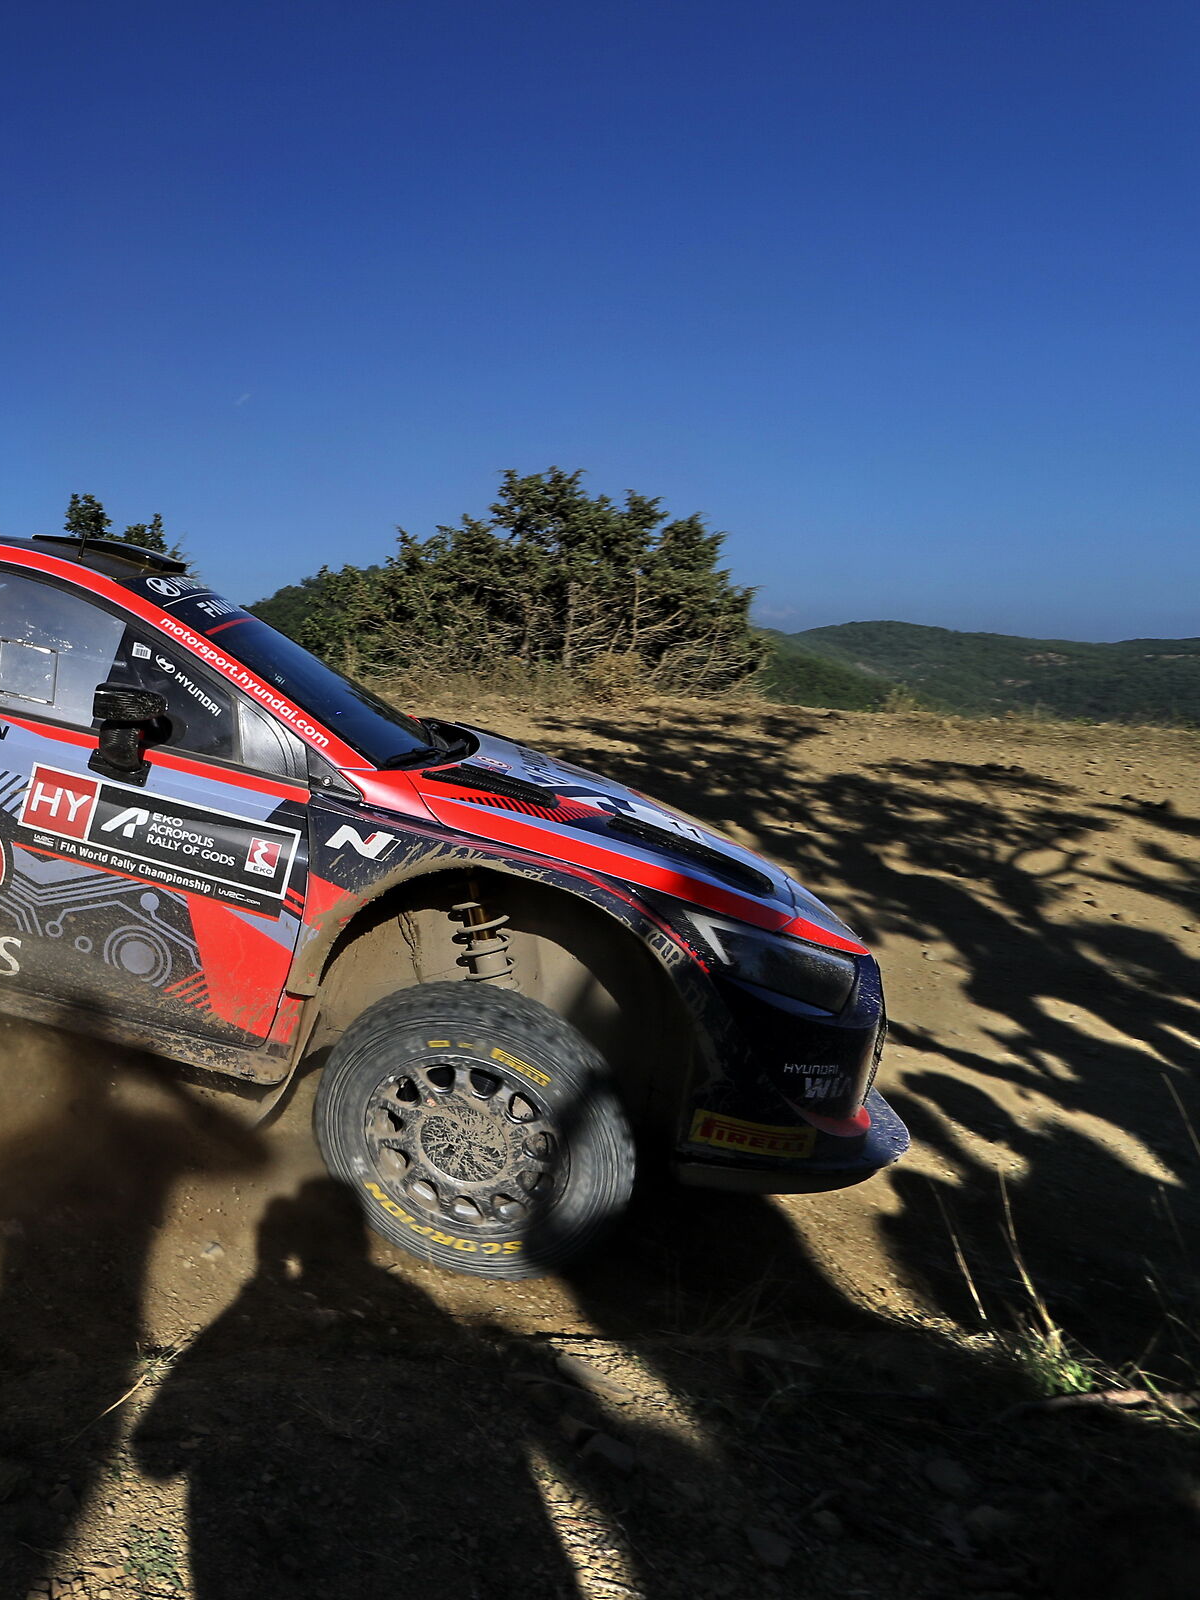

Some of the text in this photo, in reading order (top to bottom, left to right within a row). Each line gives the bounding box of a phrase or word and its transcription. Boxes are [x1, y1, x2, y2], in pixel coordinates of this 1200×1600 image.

[159, 617, 331, 749] motorsport.hyundai.com
[174, 671, 223, 718] HYUNDAI
[30, 781, 92, 823] HY
[152, 811, 184, 828] EKO
[146, 833, 236, 867] RALLY OF GODS
[148, 822, 215, 849] ACROPOLIS
[59, 841, 77, 855] FIA
[79, 846, 108, 864] World
[110, 855, 137, 873] Rally
[138, 863, 211, 894] Championship
[252, 865, 274, 876] EKO
[783, 1063, 840, 1075] HYUNDAI
[700, 1116, 810, 1153] PIRELLI
[364, 1181, 524, 1256] SCORPION
